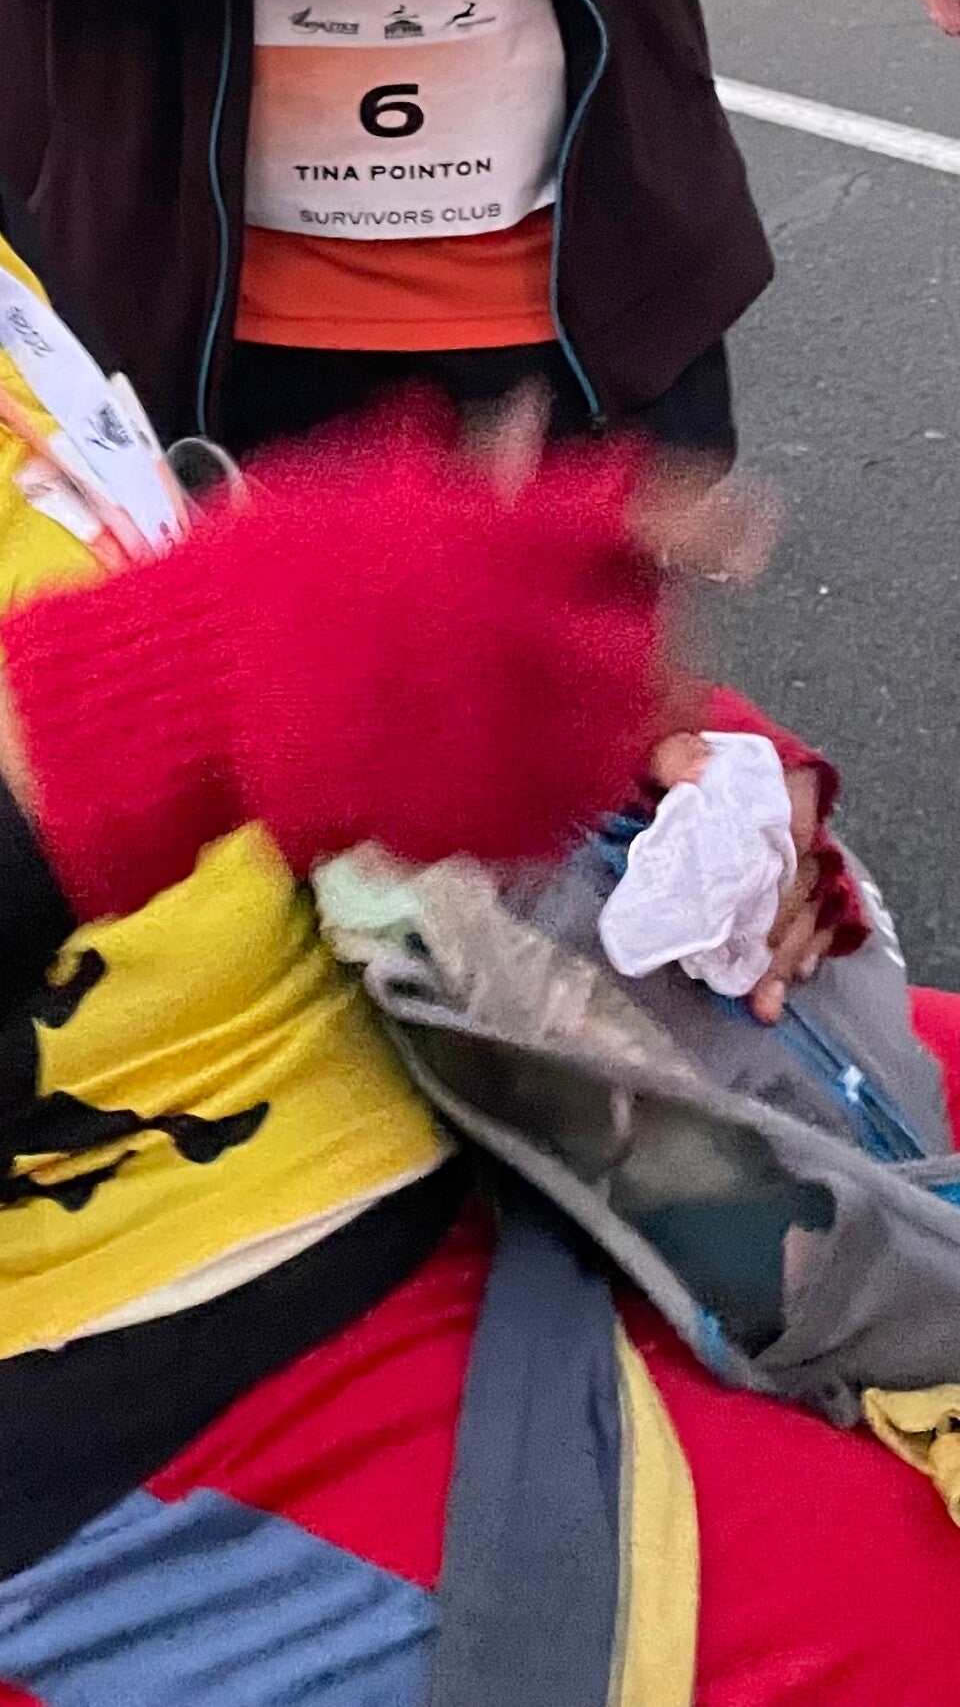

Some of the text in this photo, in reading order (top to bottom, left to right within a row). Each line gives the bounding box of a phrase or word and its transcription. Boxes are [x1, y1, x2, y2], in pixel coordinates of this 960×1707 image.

[359, 83, 425, 138] 6
[294, 157, 492, 182] TINA POINTON
[298, 202, 502, 226] SURVIVORS CLUB
